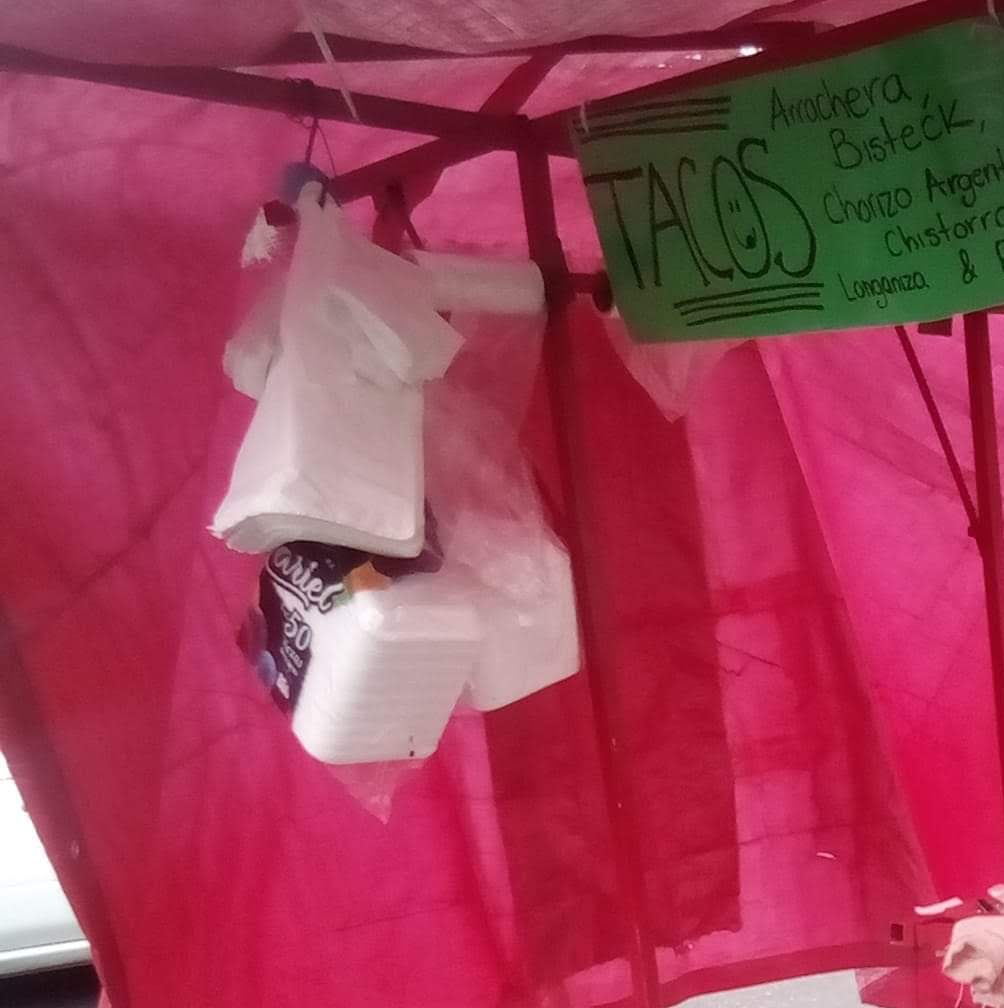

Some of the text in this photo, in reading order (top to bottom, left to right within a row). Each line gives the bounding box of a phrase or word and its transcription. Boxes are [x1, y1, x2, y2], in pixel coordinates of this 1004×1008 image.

[584, 138, 817, 291] TACOS
[823, 184, 912, 224] Chorizo
[959, 248, 978, 284] &
